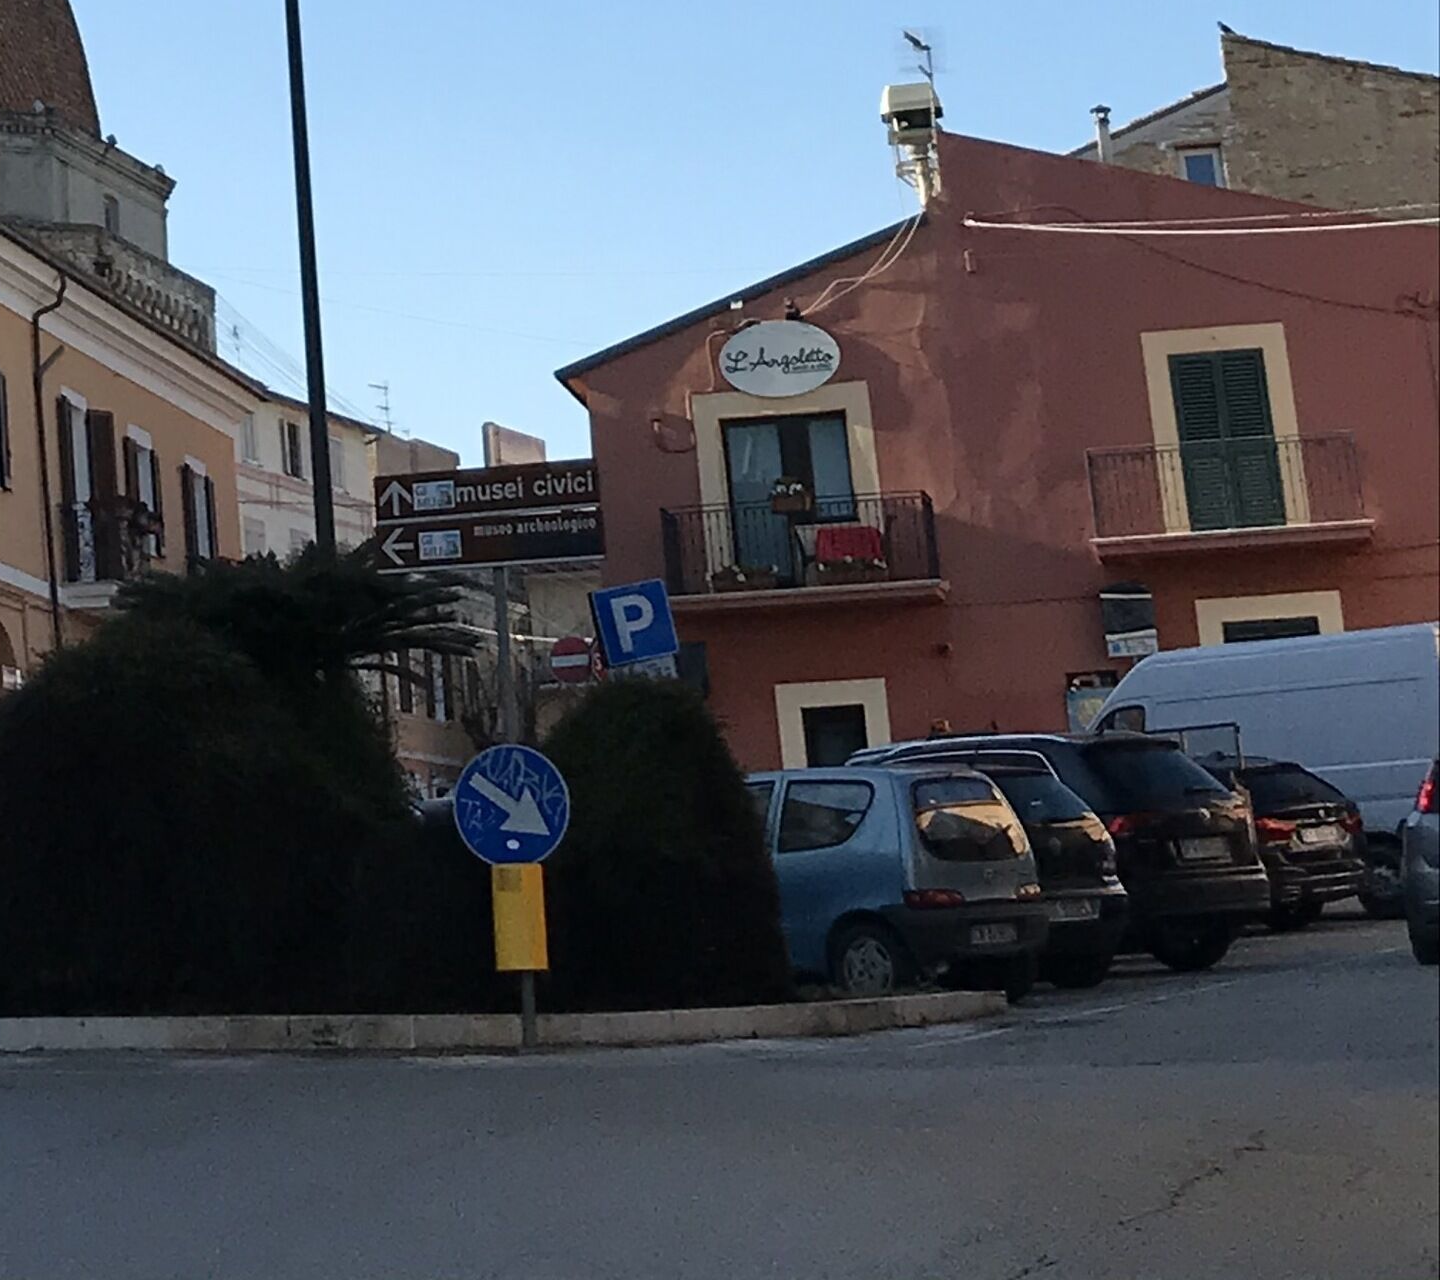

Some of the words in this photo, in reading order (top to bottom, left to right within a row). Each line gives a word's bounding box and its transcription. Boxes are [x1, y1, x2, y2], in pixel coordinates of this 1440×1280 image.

[455, 476, 524, 502] musei
[533, 470, 594, 496] civici
[474, 521, 513, 537] museo
[516, 516, 597, 535] archeologico
[610, 594, 654, 653] P
